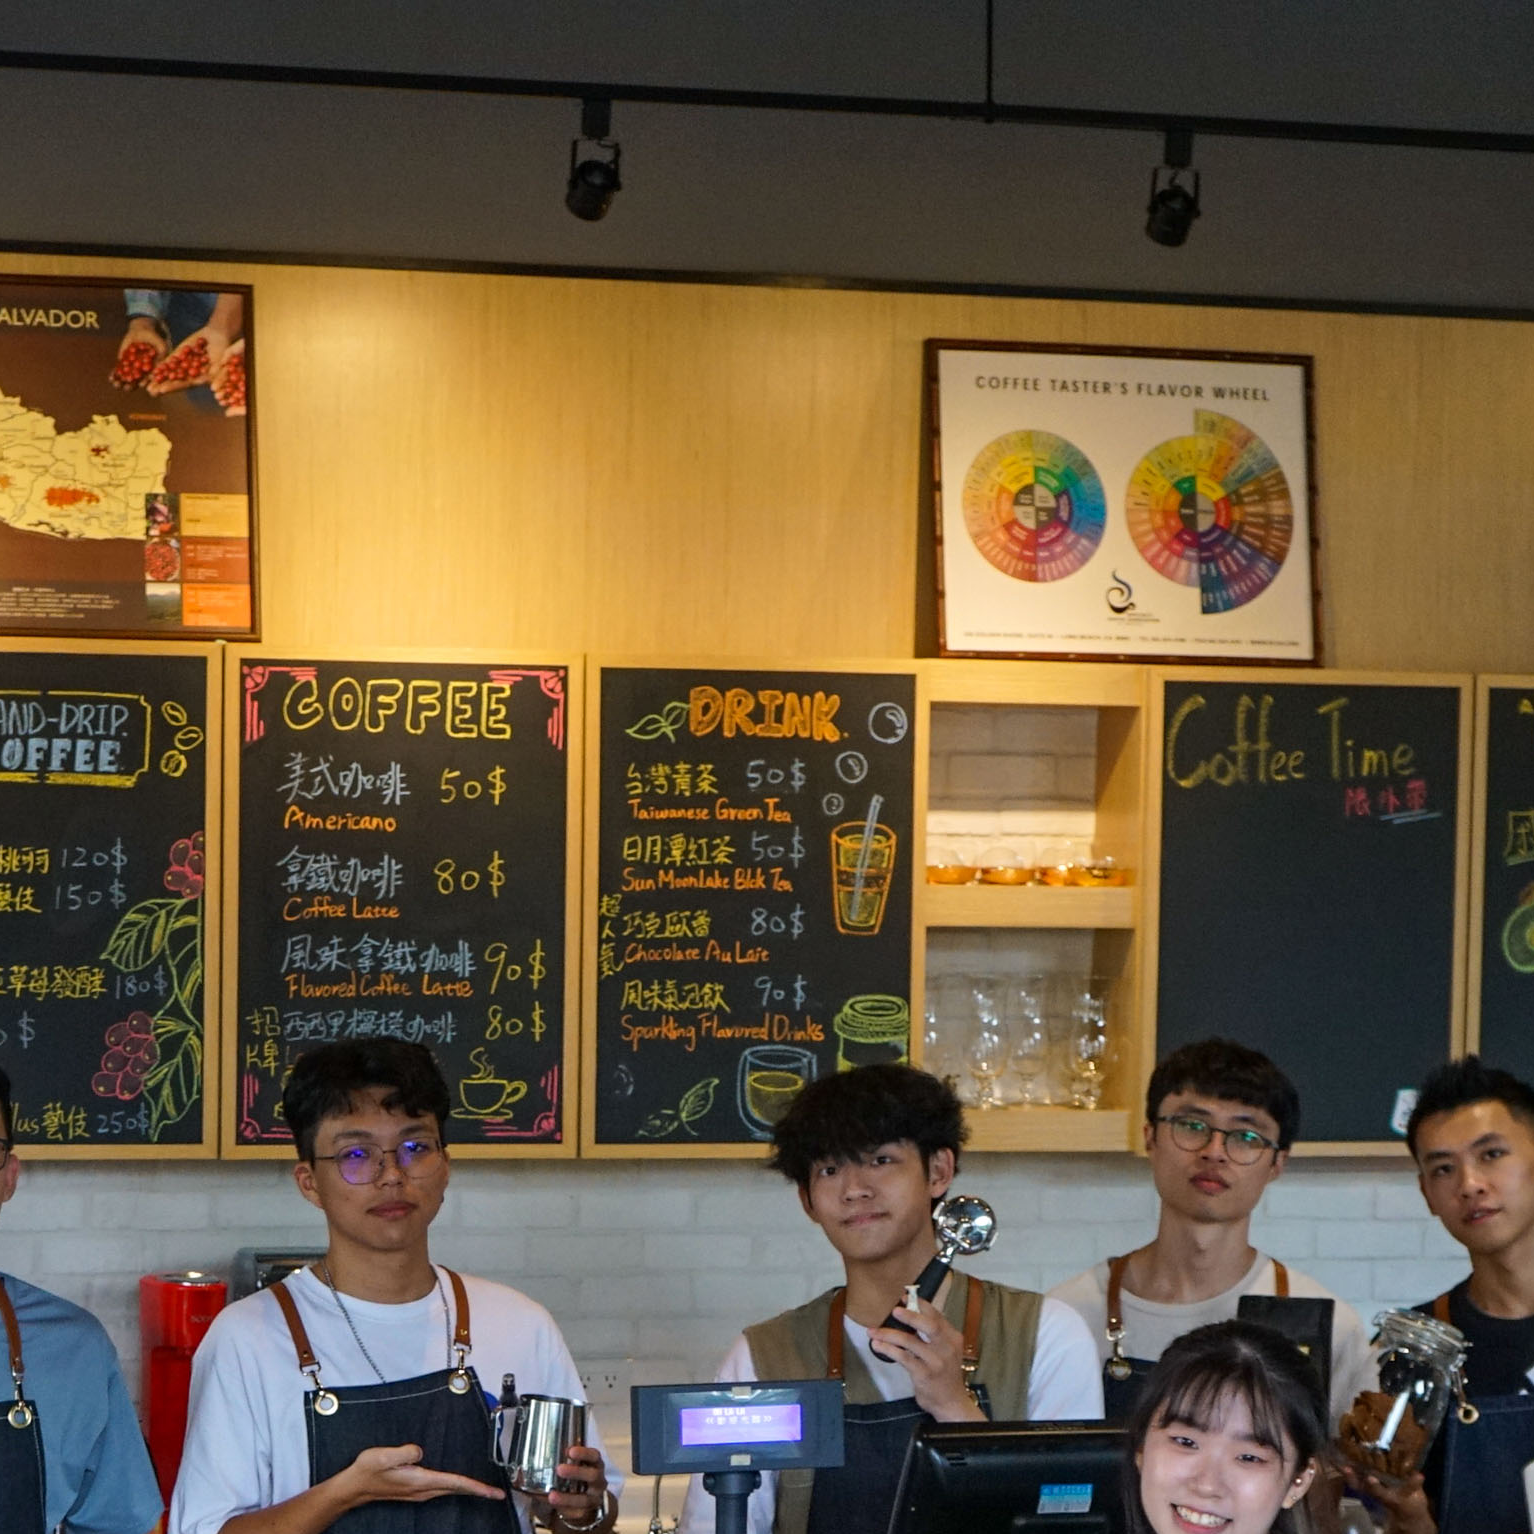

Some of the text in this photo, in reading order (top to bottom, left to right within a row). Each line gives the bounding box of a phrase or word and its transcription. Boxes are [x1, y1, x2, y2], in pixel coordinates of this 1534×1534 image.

[975, 375, 1272, 402] COFFEE TASTER'S FLAVOR WHEEL
[282, 676, 515, 740] COFFEE
[1166, 692, 1417, 790] Coffee Time
[277, 751, 507, 809] 美式咖啡 50$
[625, 758, 806, 798] 台灣青茶 50$
[283, 804, 397, 833] Americano
[625, 796, 713, 822] Taiwanese
[763, 796, 794, 825] Tea
[620, 826, 806, 868] 日月潭紅茶 50$
[275, 845, 506, 901] 拿鐵咖啡 80$
[621, 866, 657, 892] Sun
[768, 867, 794, 893] Tea
[283, 895, 400, 922] Coffee Latte
[750, 903, 806, 940] 80$
[280, 932, 546, 995] 風味拿鐵咖啡 90$
[622, 941, 703, 965] Chocolate
[703, 939, 734, 966] Au
[283, 974, 477, 1002] Flavored Coffee Latte
[754, 974, 808, 1011] 90$
[485, 1000, 547, 1042] 80$
[771, 1012, 827, 1044] Drinks
[244, 1005, 283, 1078] 招牌
